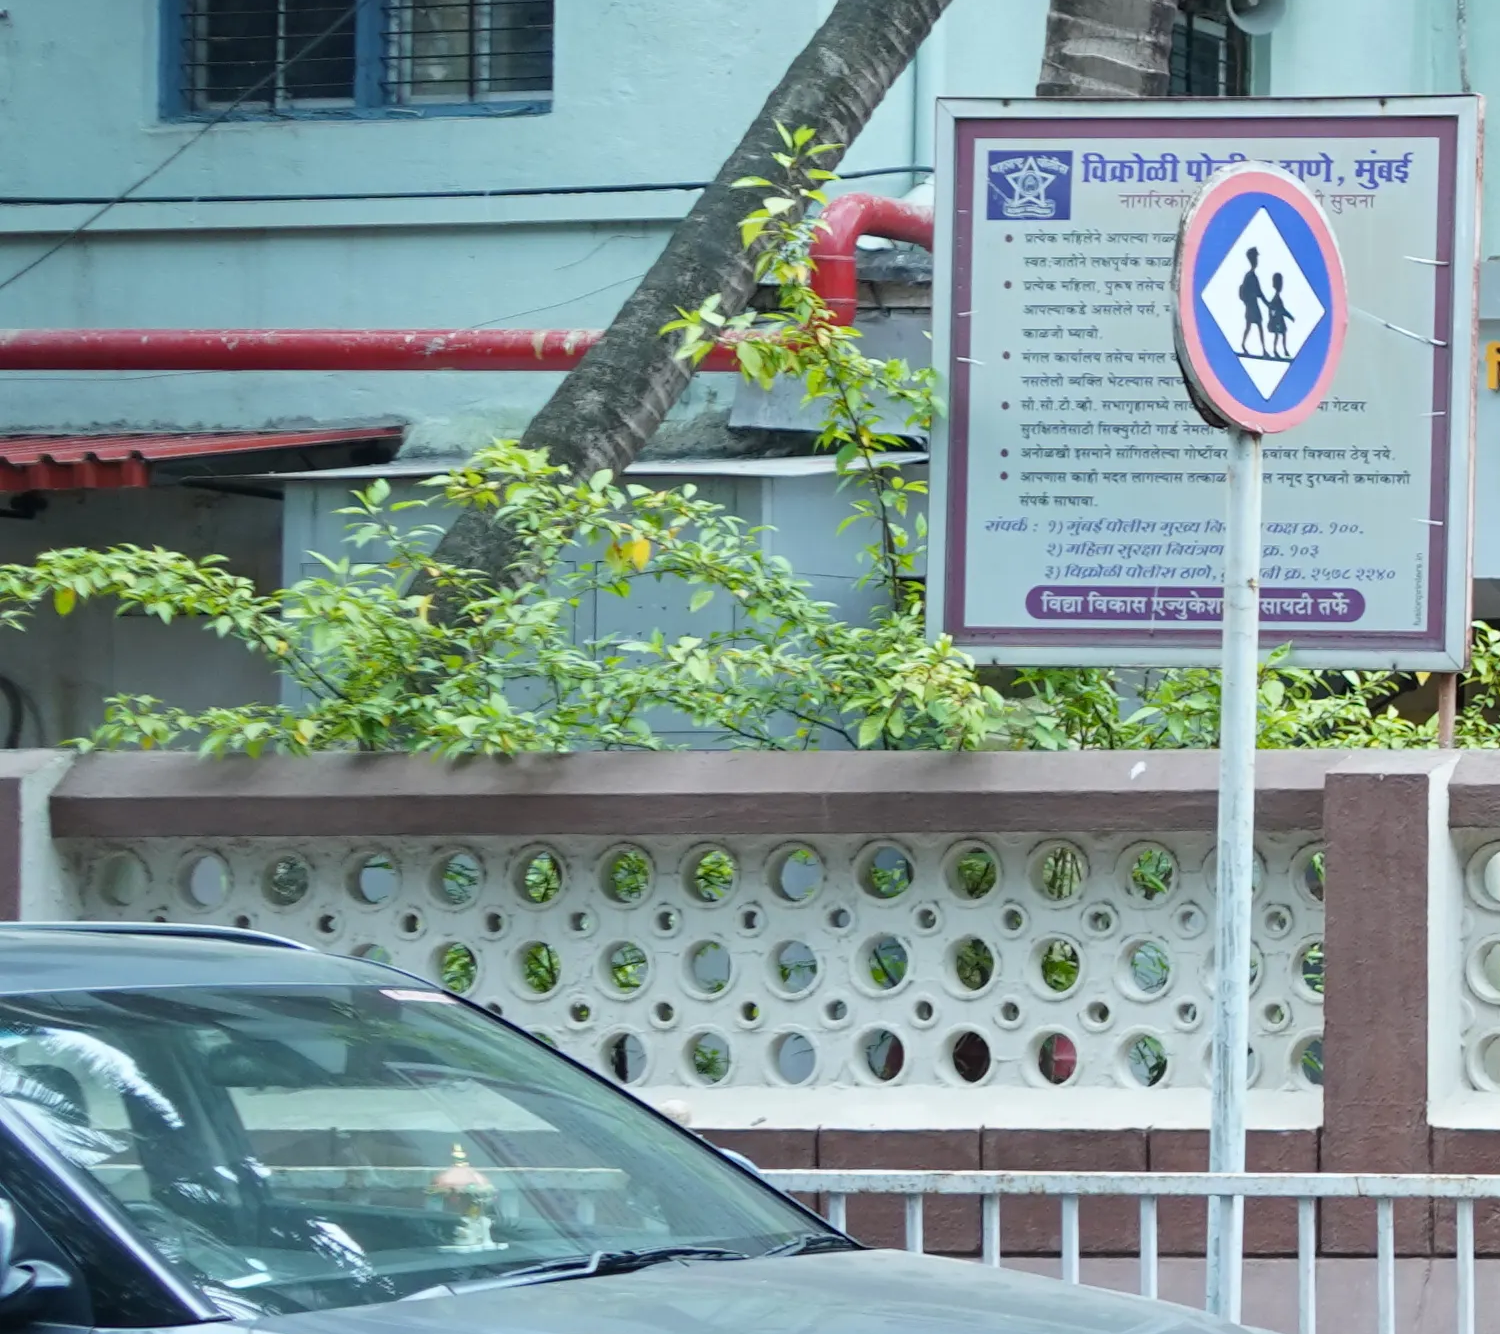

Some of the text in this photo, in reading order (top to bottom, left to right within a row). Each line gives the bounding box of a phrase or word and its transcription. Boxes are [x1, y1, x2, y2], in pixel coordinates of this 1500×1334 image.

[1081, 152, 1180, 183] विक्रोळी
[1354, 149, 1414, 189] मुंबई
[1040, 591, 1085, 614] विद्या
[1087, 591, 1148, 614] विकास
[1260, 591, 1314, 616] सायटी
